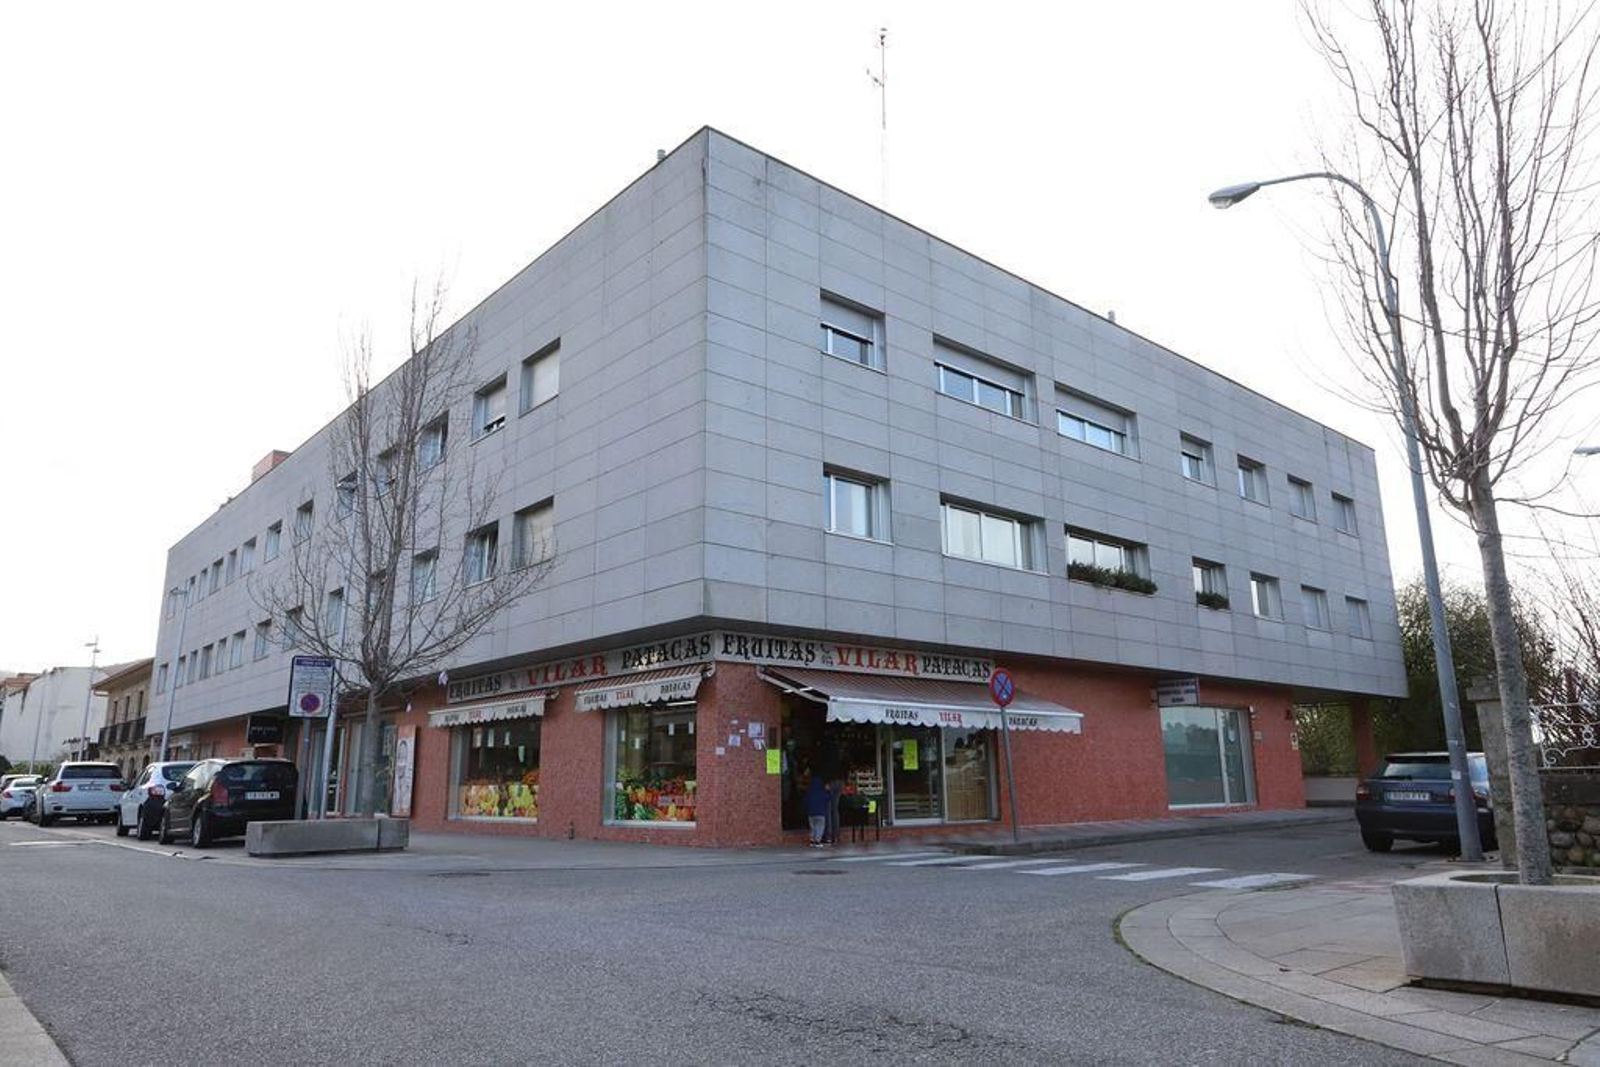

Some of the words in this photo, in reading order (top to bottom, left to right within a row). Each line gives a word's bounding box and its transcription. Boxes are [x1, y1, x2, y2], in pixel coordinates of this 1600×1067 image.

[450, 674, 501, 700] FRUITAS
[526, 653, 608, 685] VILAR
[621, 635, 711, 669] PATACAS
[722, 633, 815, 666] FRUITAS
[836, 646, 920, 675] VILAR
[922, 655, 991, 683] PATACAS
